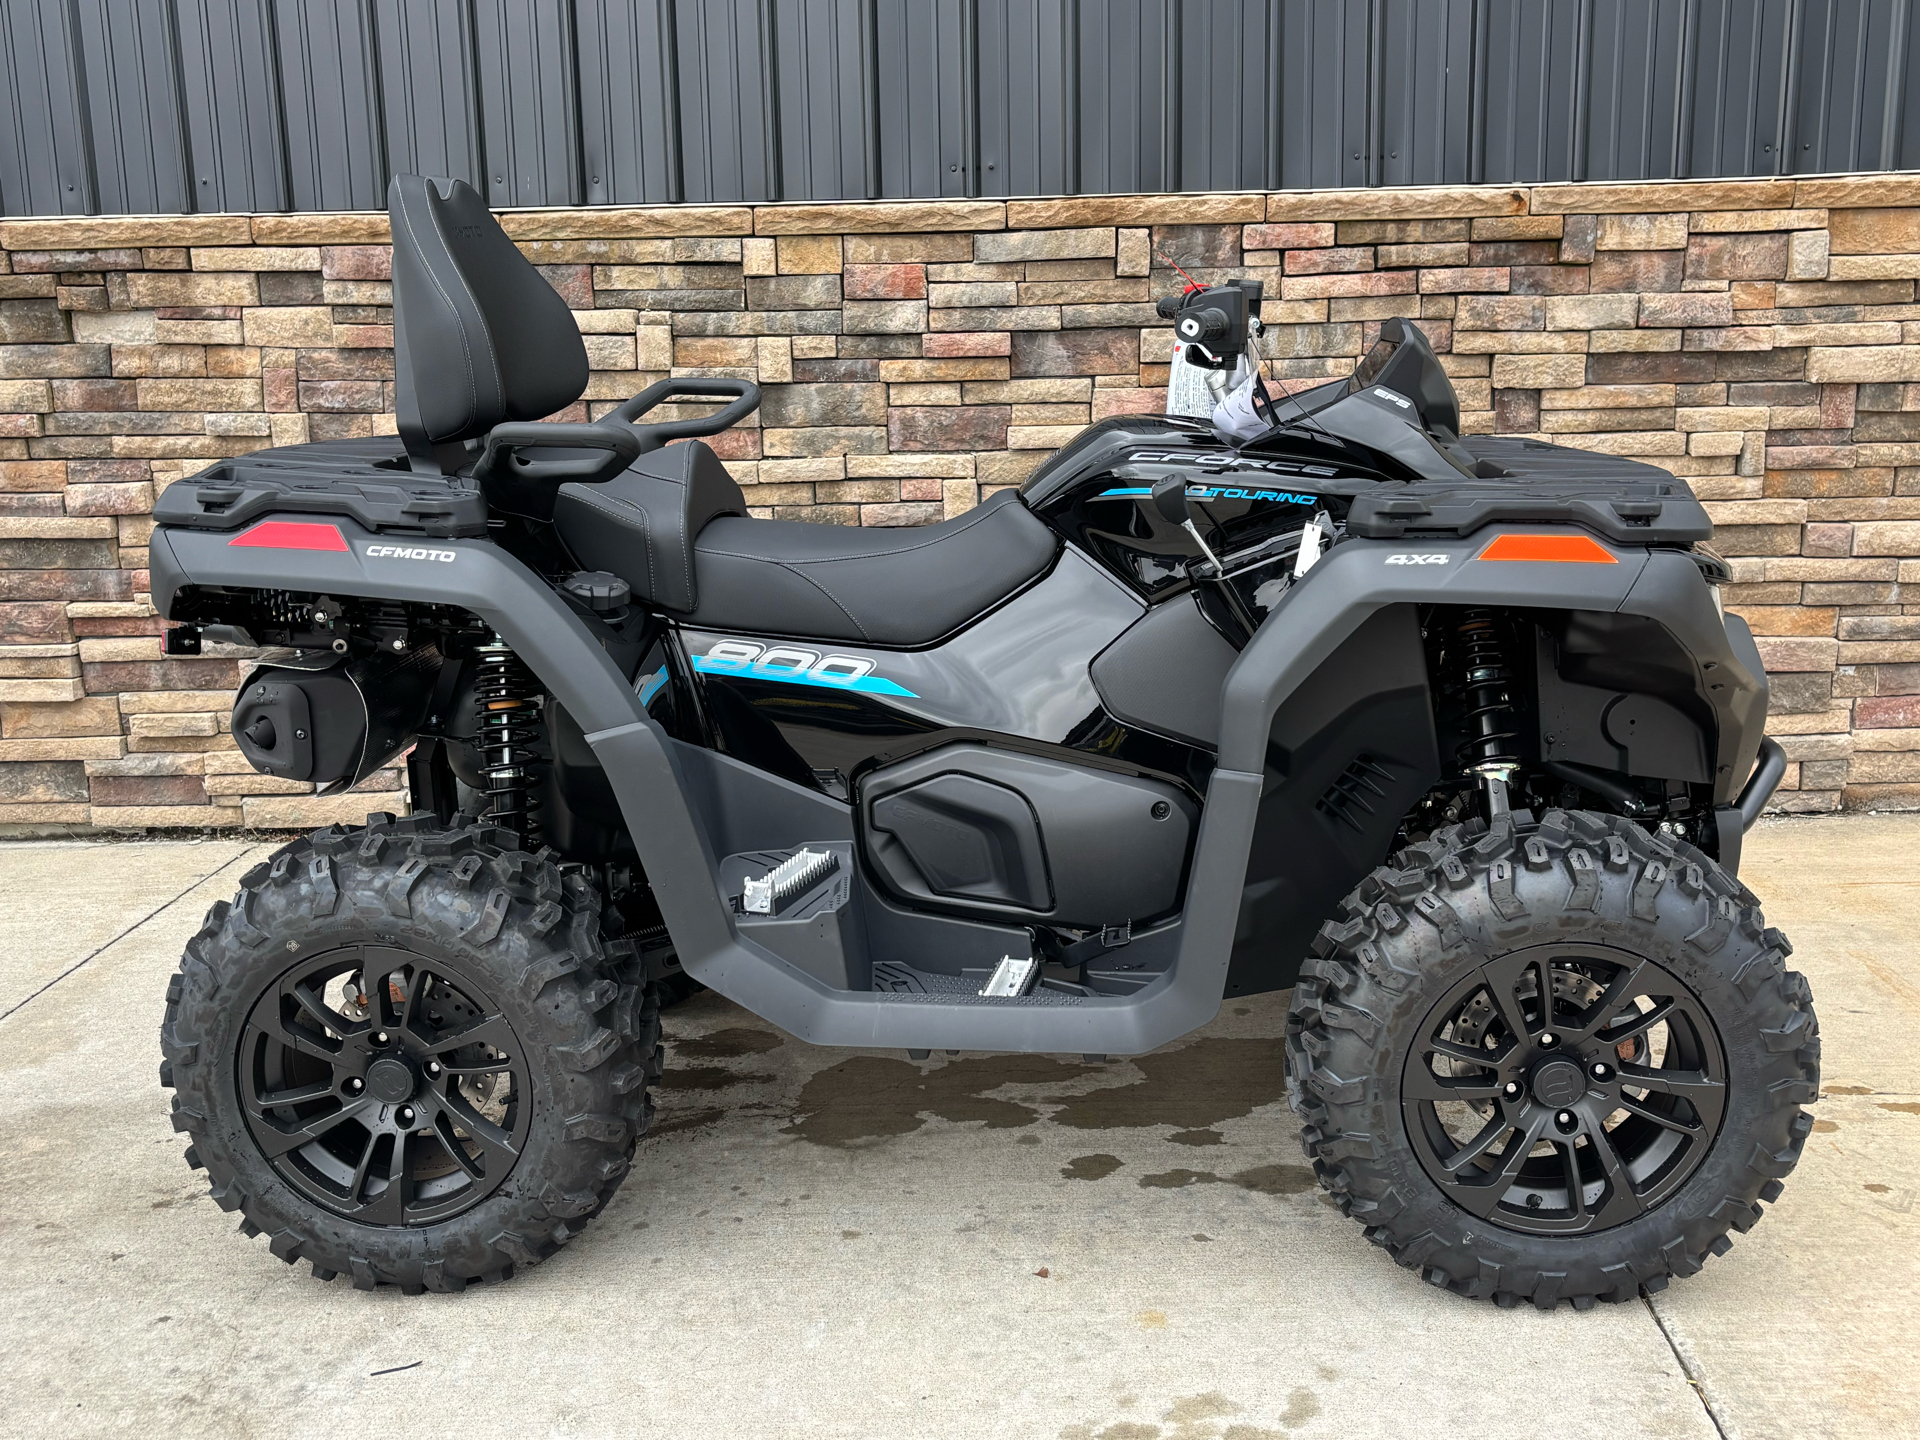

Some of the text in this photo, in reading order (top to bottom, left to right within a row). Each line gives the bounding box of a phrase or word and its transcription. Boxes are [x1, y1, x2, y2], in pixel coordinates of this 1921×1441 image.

[1373, 388, 1411, 409] EPS
[1128, 452, 1340, 476] CFORCE
[1210, 487, 1318, 505] TOURING
[366, 545, 456, 563] CFMOTO
[697, 639, 878, 687] 800
